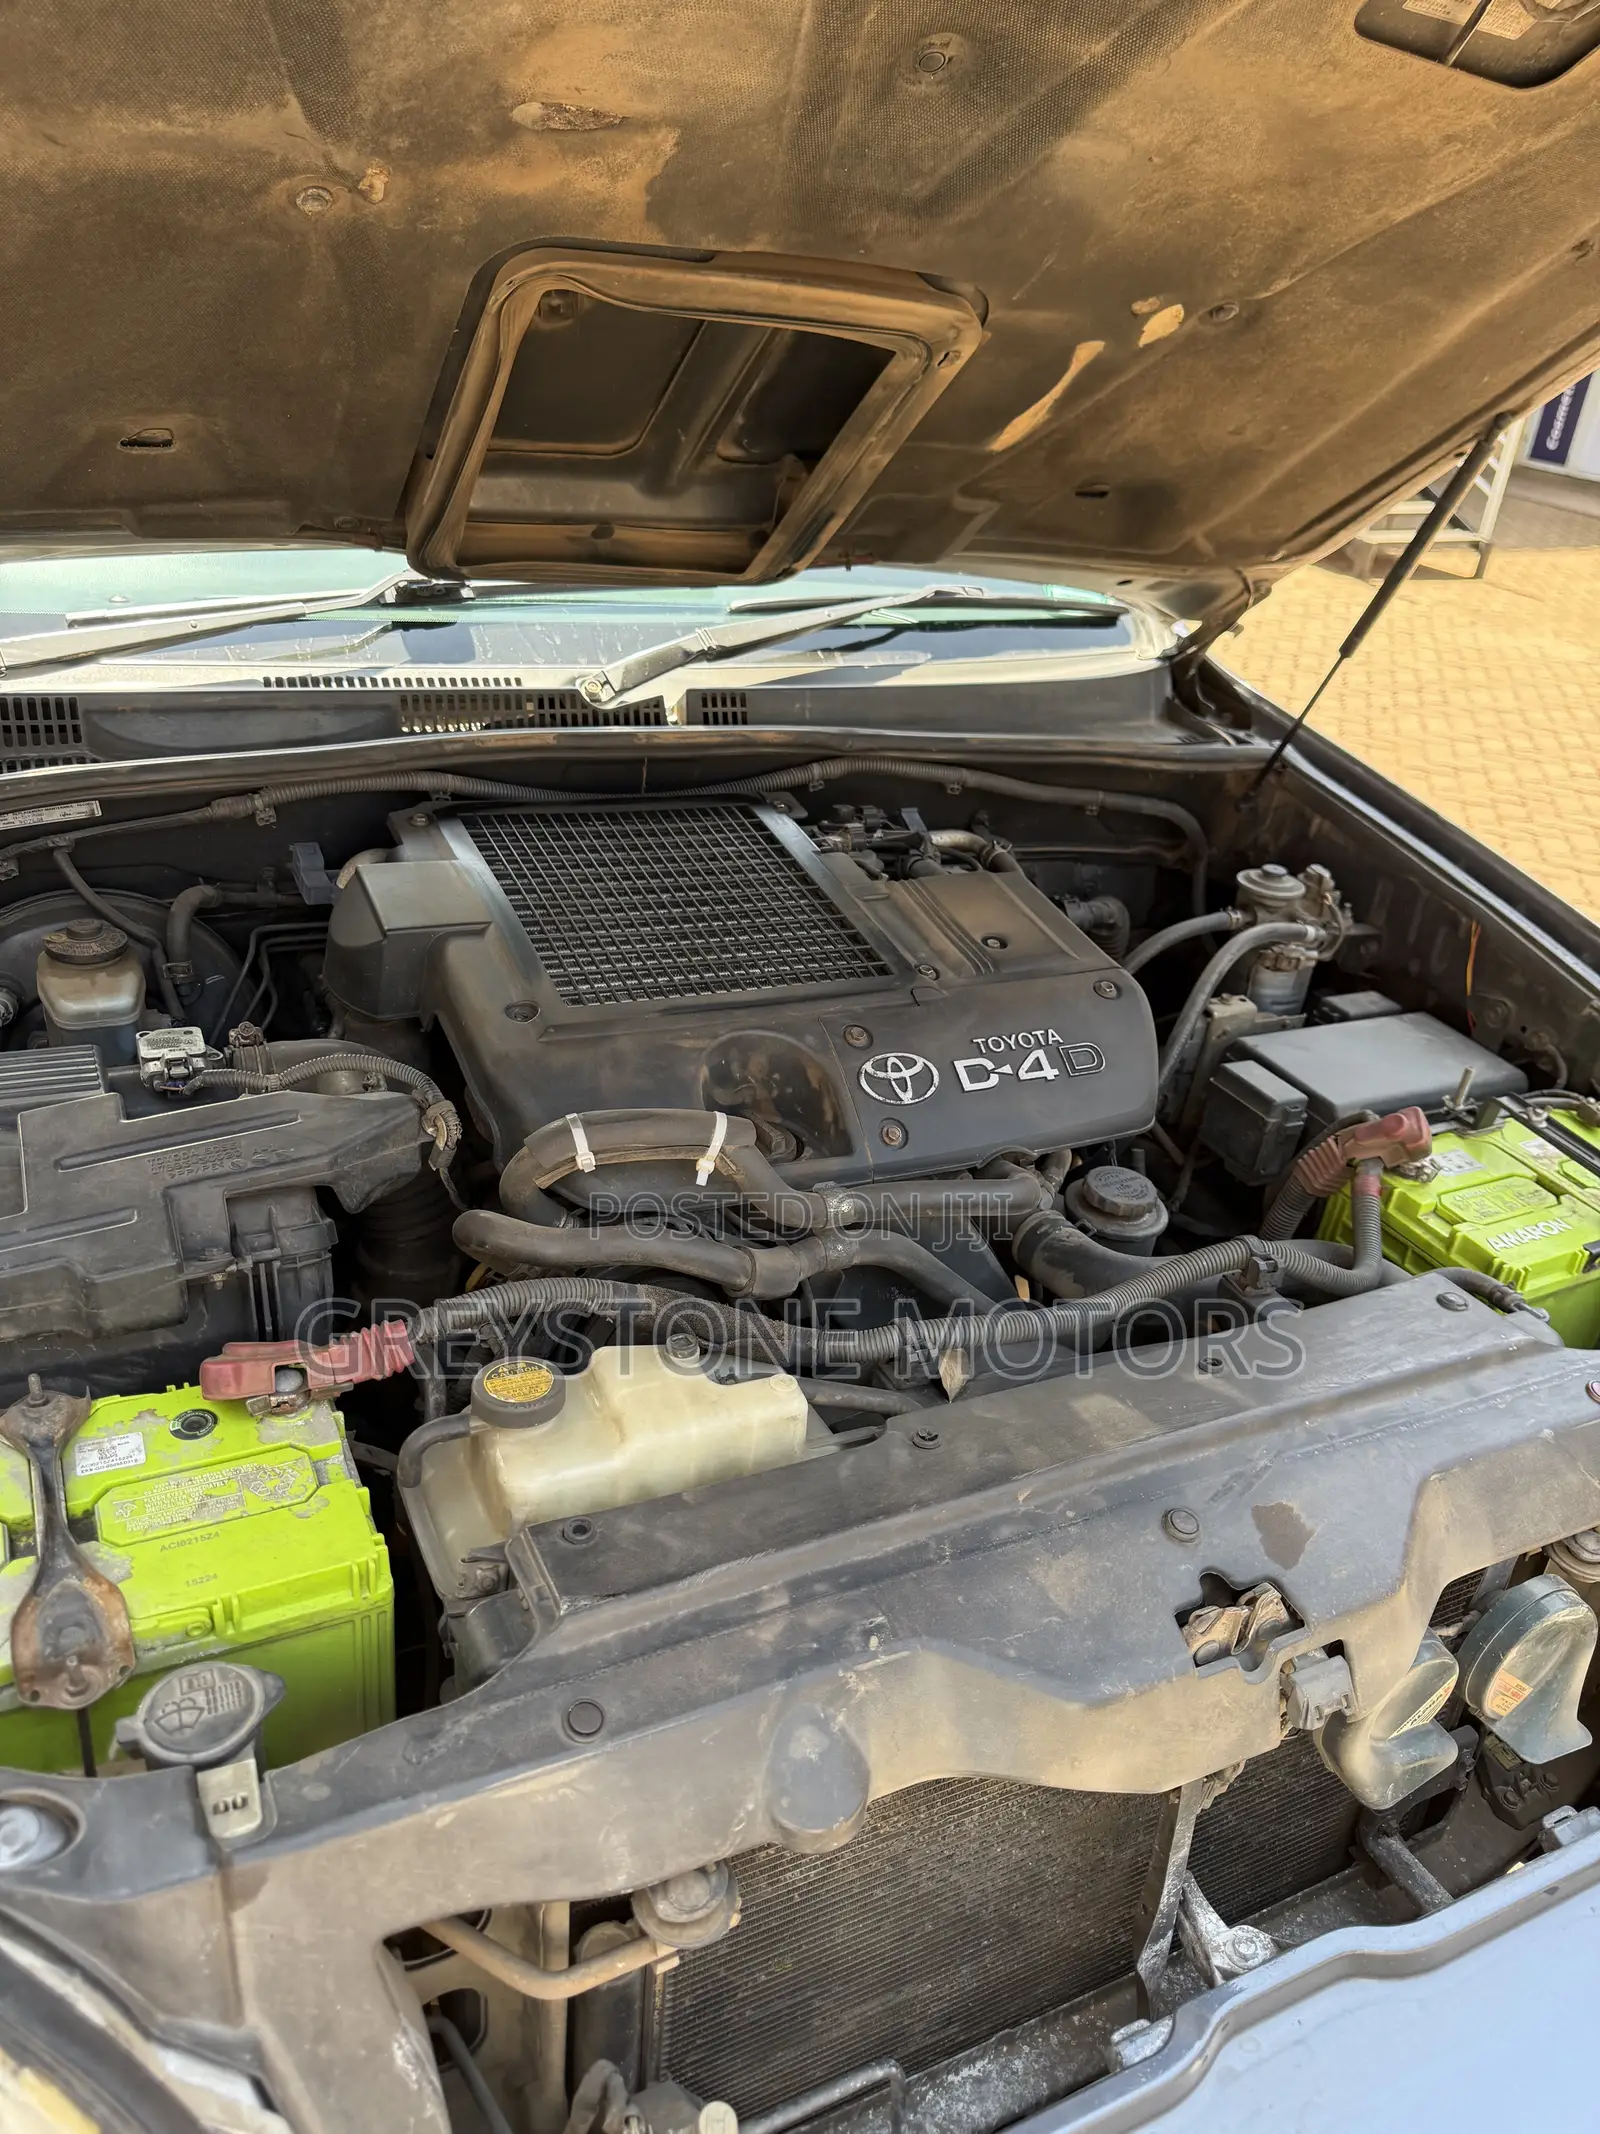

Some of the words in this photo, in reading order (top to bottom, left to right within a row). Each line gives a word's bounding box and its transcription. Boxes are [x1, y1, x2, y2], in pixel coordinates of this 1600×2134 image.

[972, 1028, 1064, 1054] TOYOTA
[953, 1042, 1106, 1092] D-4D
[1485, 1217, 1573, 1253] AMARON
[491, 1365, 539, 1379] CAUTION
